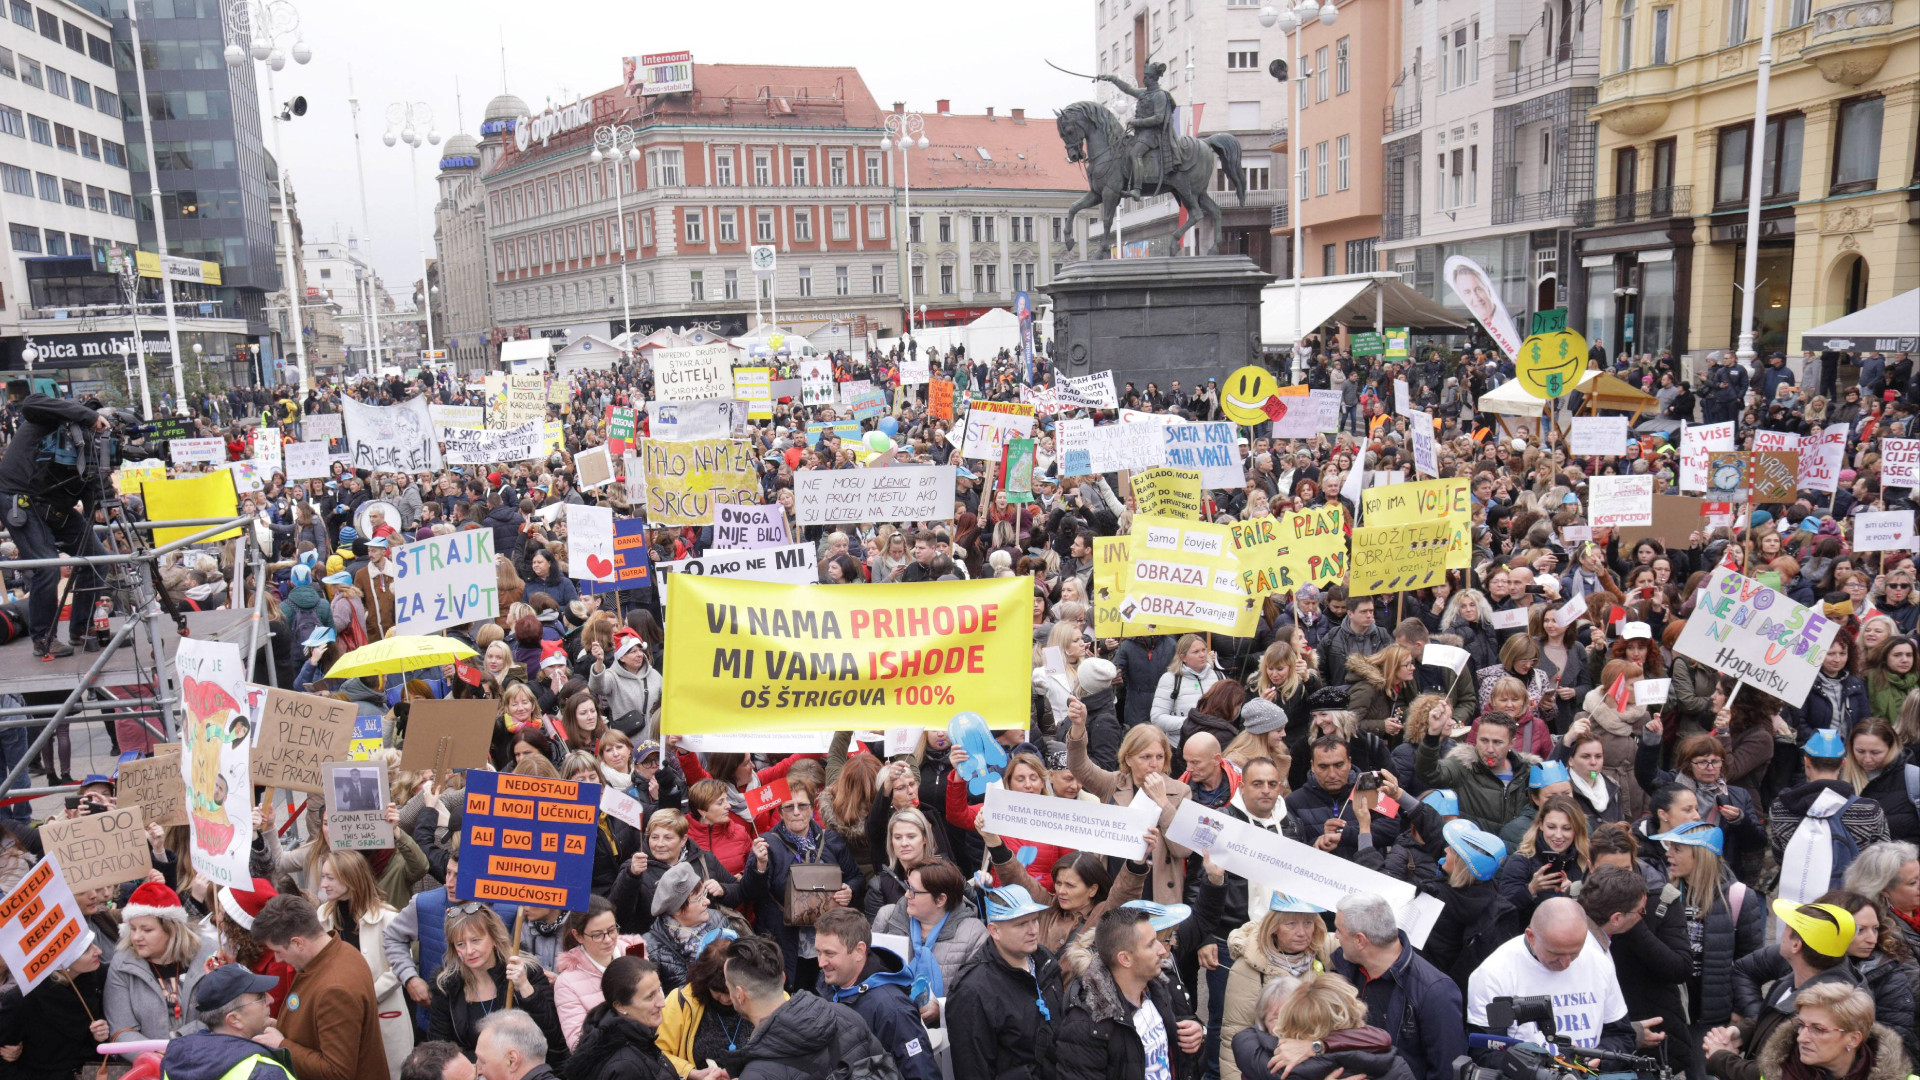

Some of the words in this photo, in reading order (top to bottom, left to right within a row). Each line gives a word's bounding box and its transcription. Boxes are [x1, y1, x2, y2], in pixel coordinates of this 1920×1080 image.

[642, 52, 690, 65] Internorm
[643, 82, 691, 94] hoco-stabil.hr
[669, 358, 712, 368] STVARAJU
[1166, 425, 1200, 444] SVETA
[1204, 423, 1234, 444] KATA
[1700, 427, 1731, 441] VIŠE
[1760, 433, 1785, 444] ONI
[353, 439, 401, 468] VRIJEME
[694, 442, 730, 473] NAM
[1197, 445, 1232, 467] VRATA
[802, 478, 822, 490] NE
[833, 477, 866, 489] MOGU
[872, 475, 912, 489] UČENICI
[919, 476, 937, 487] BITI
[1145, 471, 1175, 480] VLADO,
[1176, 472, 1200, 480] MOJA
[1760, 453, 1796, 491] VRIJEME
[802, 495, 819, 504] NA
[827, 493, 861, 505] PRVOM
[867, 491, 907, 503] MJESTU
[916, 490, 938, 501] AKO
[1160, 499, 1198, 511] HRVATSKO
[1365, 499, 1383, 513] KAD
[1387, 495, 1406, 511] IMA
[1416, 486, 1467, 518] VOLJE
[722, 508, 770, 525] OVOGA
[803, 508, 820, 521] SU
[868, 506, 884, 518] NA
[891, 504, 936, 518] ZADNJEM
[718, 526, 748, 545] NIJE
[757, 526, 782, 542] BILO
[1232, 520, 1276, 549] FAIR
[1294, 509, 1340, 538] PLAY
[1359, 526, 1428, 548] ULOŽITE
[1435, 522, 1447, 541] U
[1873, 533, 1893, 541] POZIV
[617, 537, 641, 546] DANAS,
[1148, 531, 1176, 545] Samo
[1184, 537, 1218, 550] čovjek
[395, 531, 492, 579] ŠTRAJK
[710, 561, 741, 575] AKO
[746, 558, 766, 570] NE
[775, 549, 813, 571] MI,
[621, 569, 645, 578] SUTRA!
[1136, 563, 1204, 586] OBRAZA
[1215, 575, 1228, 585] ne
[1242, 566, 1294, 595] FAIR
[1308, 551, 1344, 580] PAY
[1365, 569, 1378, 578] ne
[1384, 568, 1391, 576] u
[1397, 561, 1425, 574] vozni
[397, 592, 425, 623] ZA
[435, 583, 497, 621] ŽIVOT
[1699, 591, 1735, 619] NE
[1732, 605, 1757, 630] BI
[1721, 573, 1775, 610] OVO
[1785, 605, 1828, 642] SE
[705, 602, 739, 634] VI
[748, 606, 841, 639] NAMA
[850, 603, 999, 639] PRIHODE
[1705, 622, 1732, 643] NI
[1764, 643, 1787, 665] U
[212, 659, 222, 672] JE
[712, 647, 755, 679] MI
[765, 650, 859, 681] VAMA
[868, 644, 985, 681] ISHODE
[1715, 648, 1789, 693] Hogwartsu
[740, 685, 770, 709] OŠ
[775, 684, 886, 708] ŠTRIGOVA
[895, 684, 955, 706] 100%
[274, 697, 313, 718] KAKO
[319, 706, 344, 724] JE
[279, 721, 334, 749] PLENKI
[120, 763, 178, 791] PODRŽAVAMO
[505, 778, 577, 796] NEDOSTAJU
[135, 783, 164, 802] SVOJE
[330, 813, 362, 825] GONNA
[364, 813, 385, 822] TELL
[469, 798, 486, 812] MI
[501, 801, 533, 815] MOJI
[540, 803, 593, 823] UČENICI,
[1007, 803, 1031, 815] NEMA
[1032, 807, 1071, 821] REFORME
[1072, 811, 1110, 828] ŠKOLSTVA
[1111, 821, 1127, 831] BEZ
[47, 822, 85, 843] WE
[99, 811, 133, 833] DO
[341, 824, 354, 832] MY
[356, 823, 376, 832] KIDS
[343, 832, 359, 840] THIS
[361, 832, 376, 840] WAS
[992, 812, 1029, 826] REFORME
[1029, 817, 1063, 830] ODNOSA
[1064, 822, 1094, 835] PREMA
[1094, 827, 1142, 845] UČITELJIMA.
[57, 838, 105, 862] NEED
[112, 829, 145, 850] THE
[335, 839, 350, 848] THE
[353, 839, 386, 848] GRINCH
[473, 831, 493, 843] ALI
[503, 833, 531, 847] OVO
[543, 836, 557, 848] JE
[565, 838, 583, 850] ZA
[495, 860, 550, 877] NJIHOVU
[1226, 840, 1251, 858] MOŽE
[1249, 850, 1258, 862] LI
[1256, 852, 1293, 874] REFORMA
[1293, 864, 1345, 893] OBRAZOVANJA
[0, 860, 51, 919] UČITELJI
[482, 881, 563, 903] BUDUĆNOST!
[21, 903, 39, 924] SU
[26, 911, 60, 947] REKLI
[29, 927, 75, 975] DOSTA!
